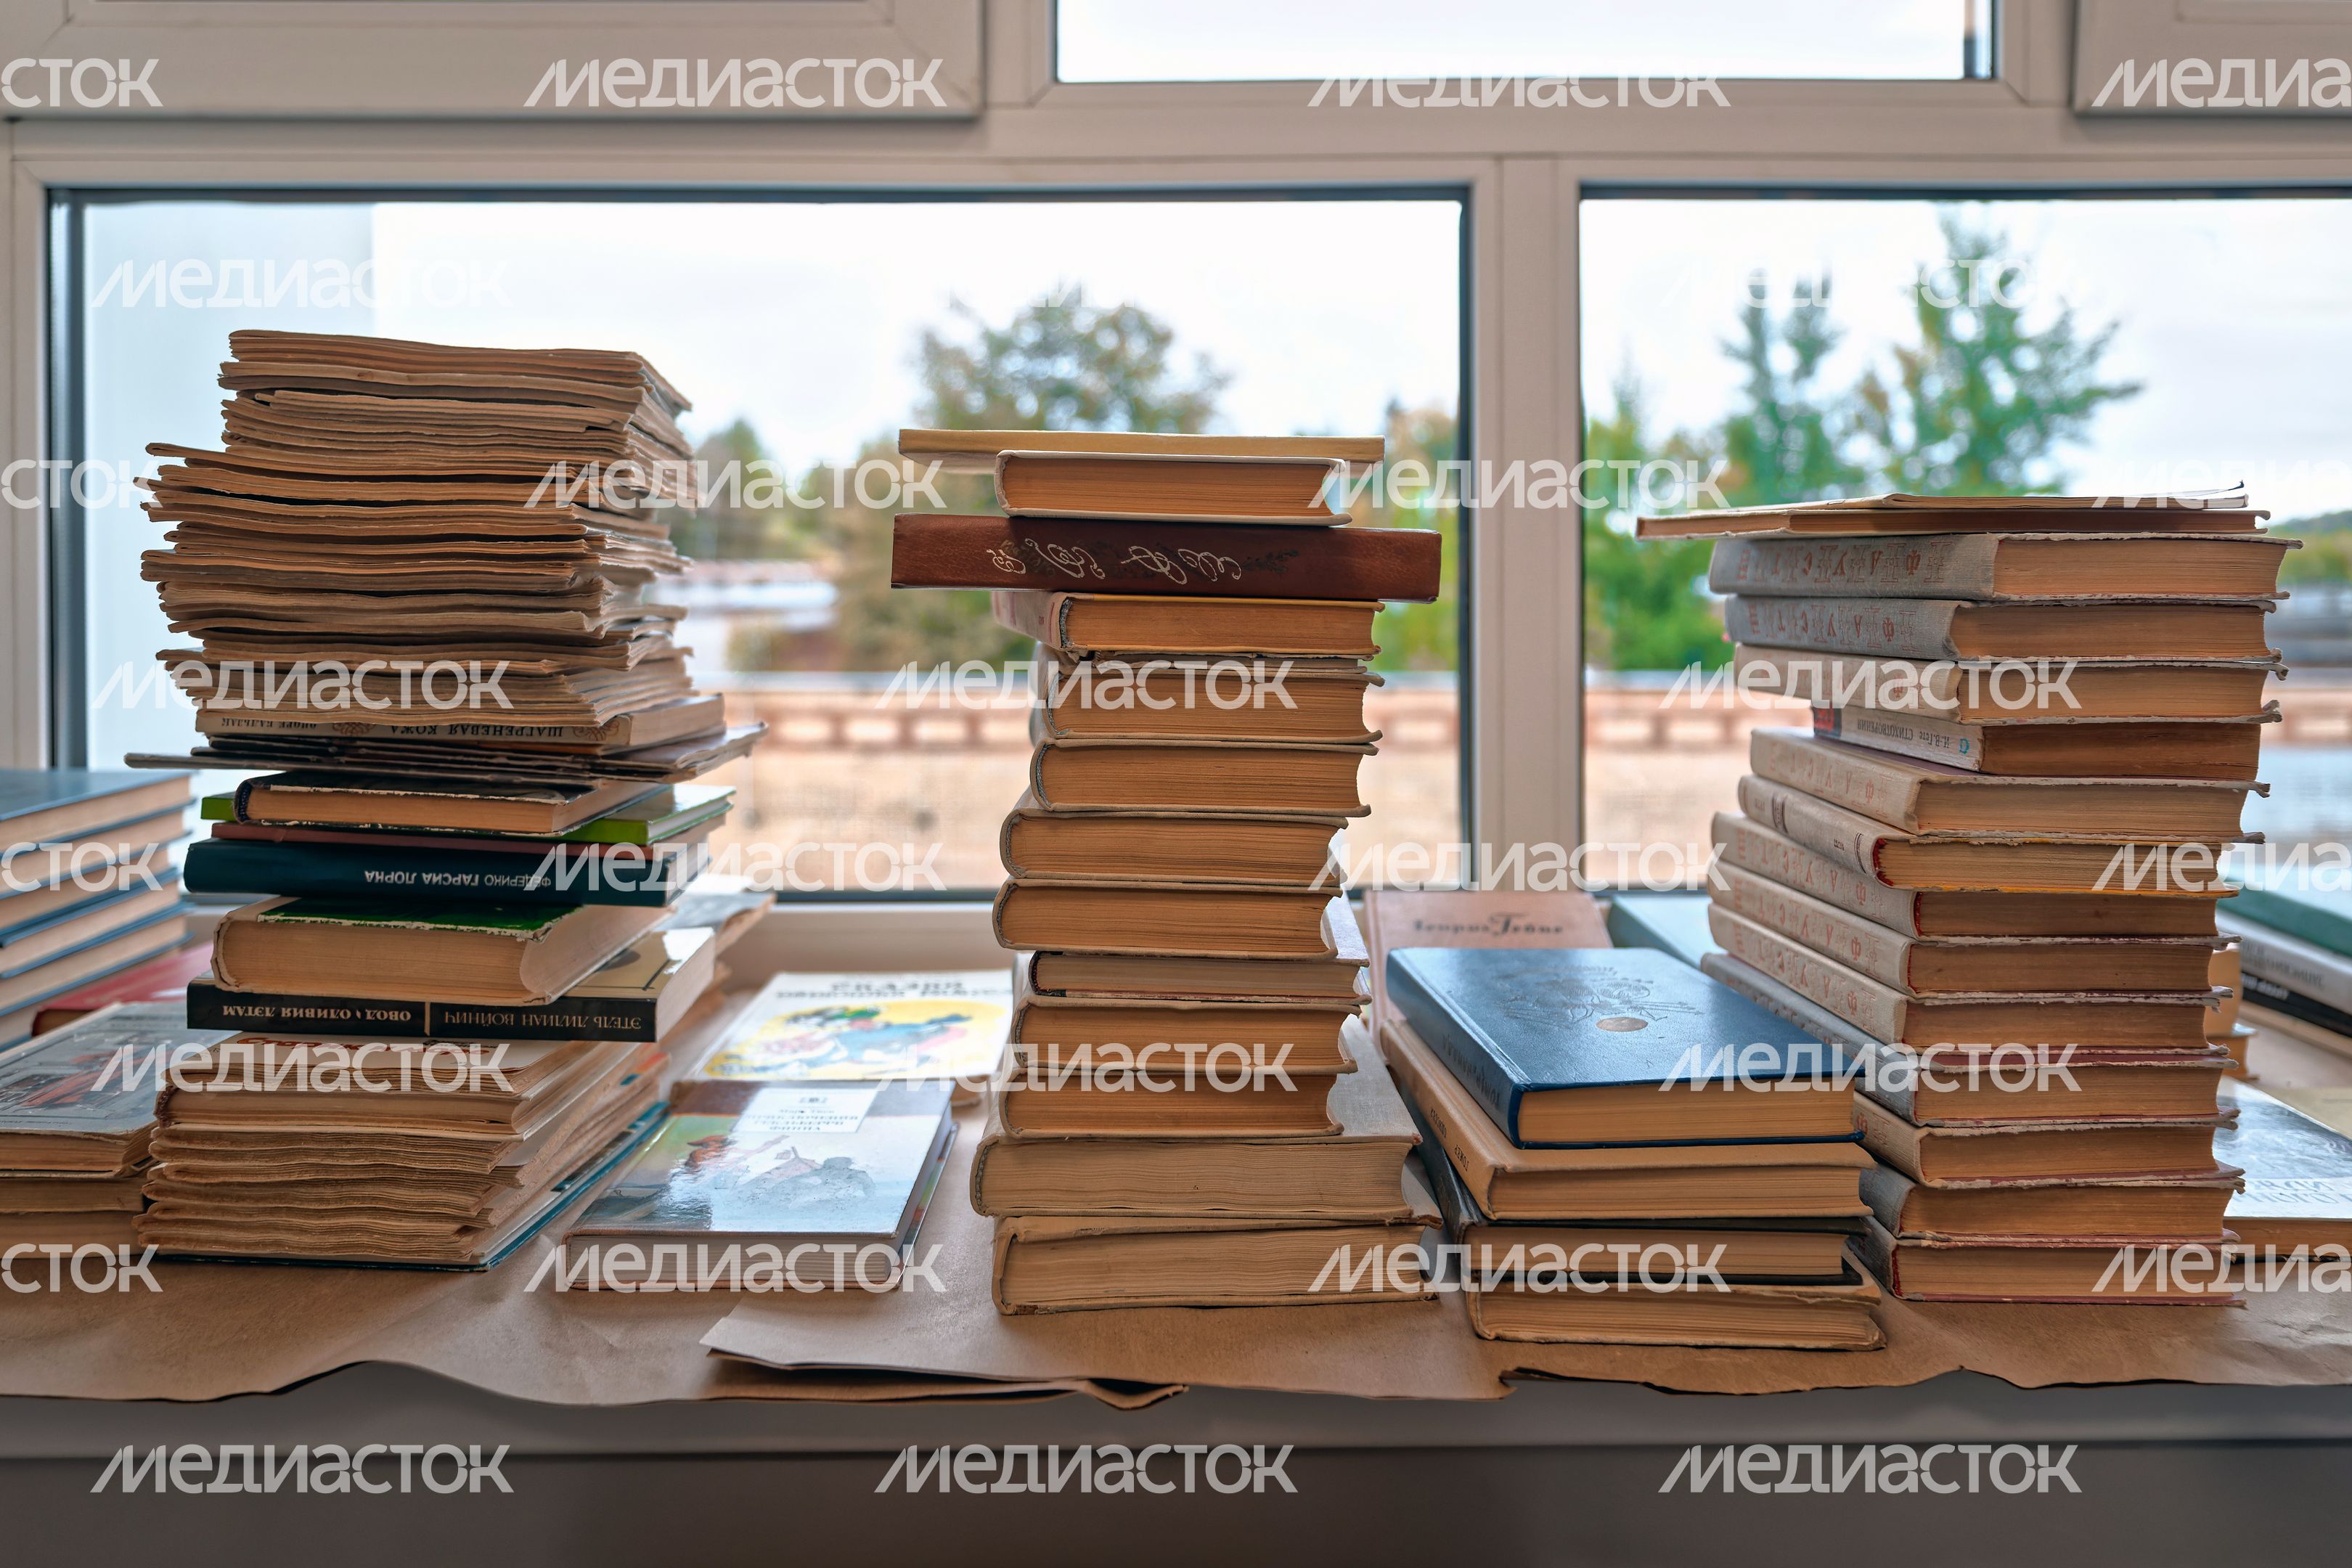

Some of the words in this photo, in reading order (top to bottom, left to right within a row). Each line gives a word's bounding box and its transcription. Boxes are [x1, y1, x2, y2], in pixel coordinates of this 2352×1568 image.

[448, 724, 563, 738] ШАГРЕНЕВАЯ
[364, 870, 417, 884] ЛОРКА
[421, 872, 479, 886] ГАРСИА
[222, 1005, 276, 1018] ЛЭТАМ
[280, 1007, 352, 1020] ОЛИВИЯ
[365, 1008, 412, 1022] ОВОД
[444, 1011, 514, 1027] ВОЙНИЧ
[522, 1014, 589, 1029] ЛИЛИАН
[594, 1016, 642, 1029] ЭТЕЛЬ
